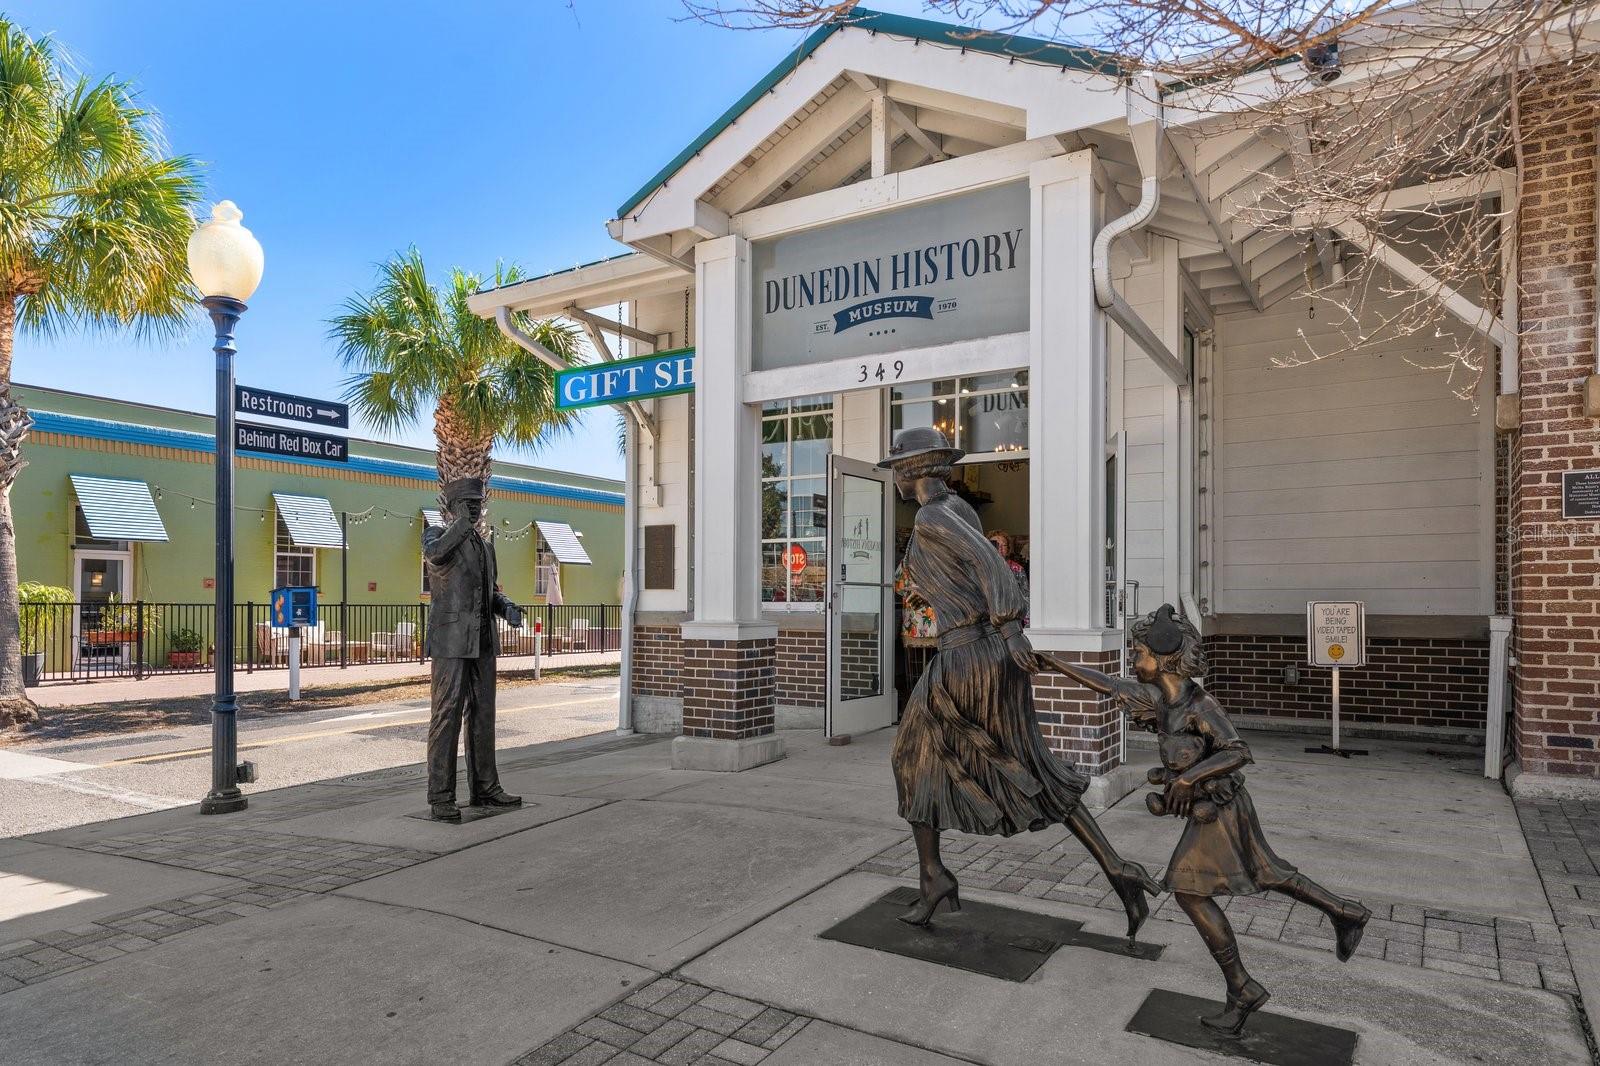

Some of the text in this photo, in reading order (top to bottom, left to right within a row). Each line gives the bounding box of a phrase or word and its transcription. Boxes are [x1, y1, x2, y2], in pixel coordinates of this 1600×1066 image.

[765, 229, 1023, 314] DUNEDIN HISTORY
[848, 300, 919, 322] MUSEUM
[938, 301, 957, 310] 1970
[815, 323, 829, 332] EST.
[858, 360, 904, 383] 349
[564, 366, 644, 402] GIFT
[241, 391, 313, 419] Restrooms
[983, 391, 1025, 412] DUN
[238, 428, 342, 457] Behind Red Box Car
[1321, 607, 1351, 616] YOU ARE
[1325, 616, 1347, 625] BEING
[1316, 626, 1357, 634] VIDEO TAPED
